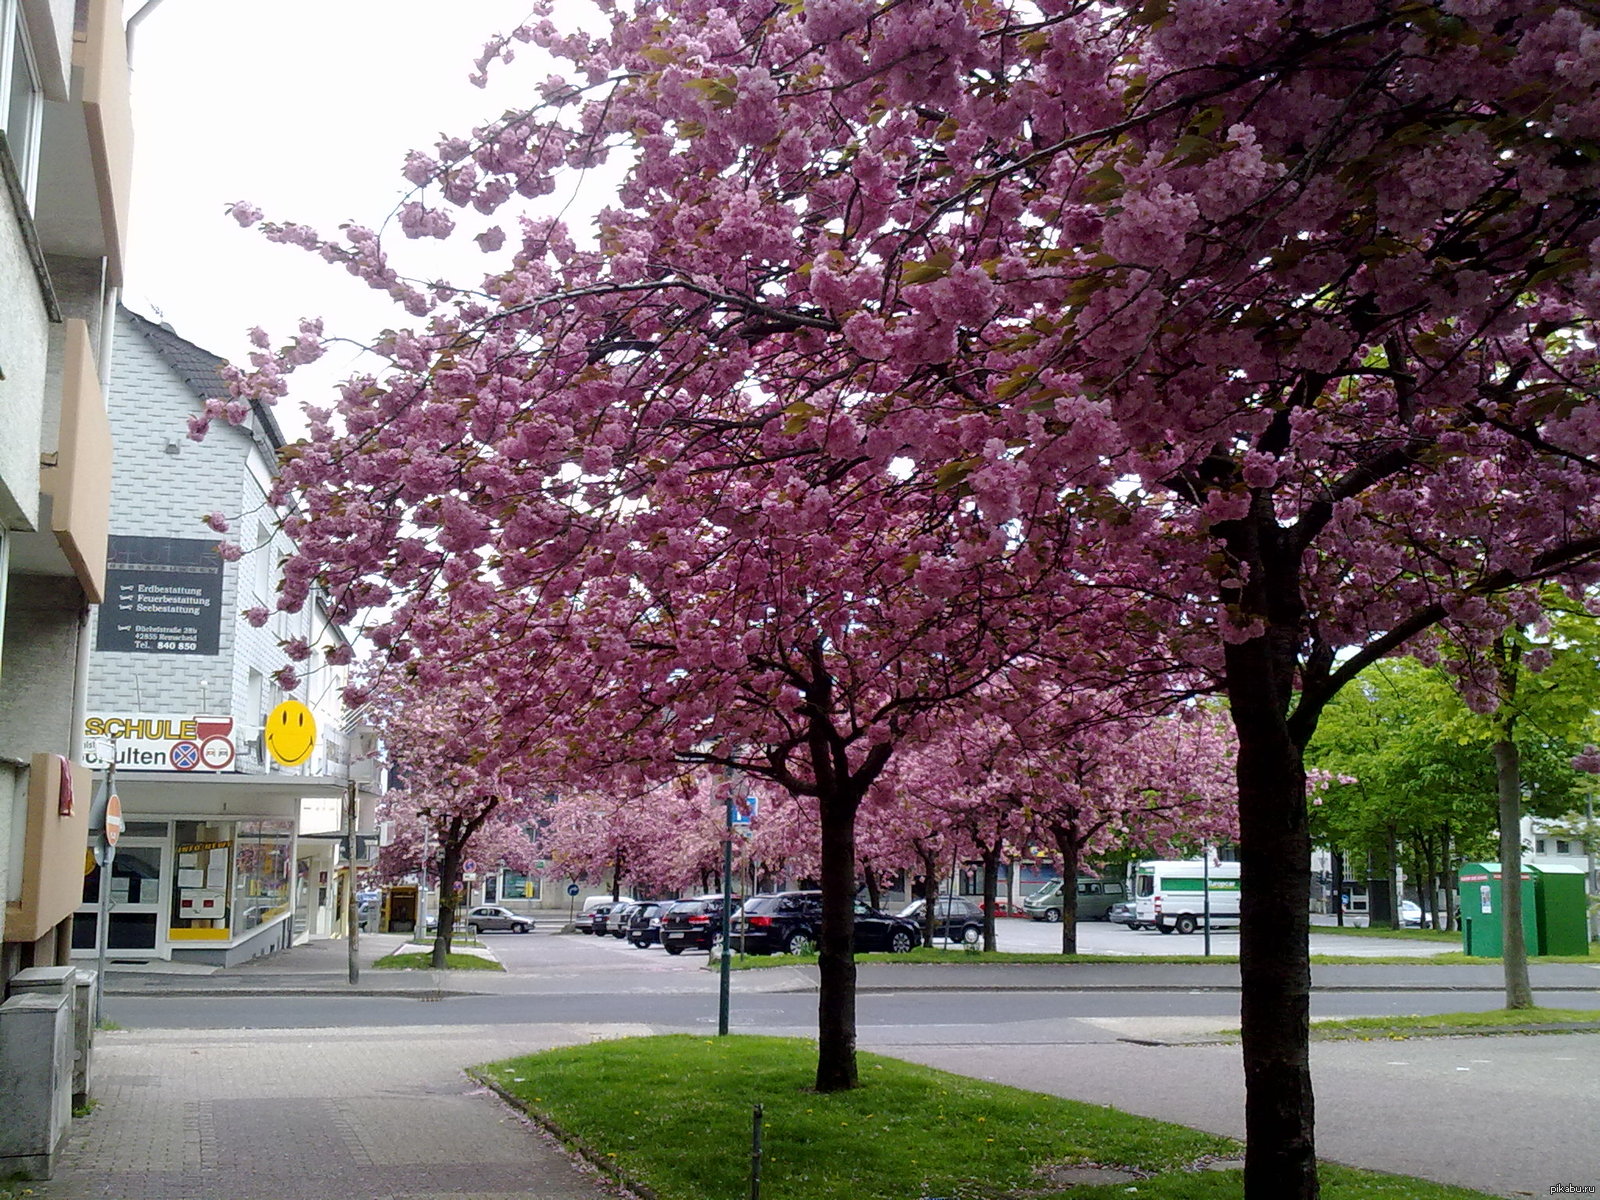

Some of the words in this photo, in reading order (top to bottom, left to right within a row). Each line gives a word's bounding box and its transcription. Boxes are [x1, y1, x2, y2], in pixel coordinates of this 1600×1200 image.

[137, 584, 203, 596] Erdbestattung
[137, 593, 211, 607] Feuerbestattung
[136, 603, 201, 615] Seebestattung
[134, 641, 151, 649] Tel.
[157, 641, 176, 650] 840
[177, 642, 197, 651] 850
[85, 717, 198, 741] SCHULE
